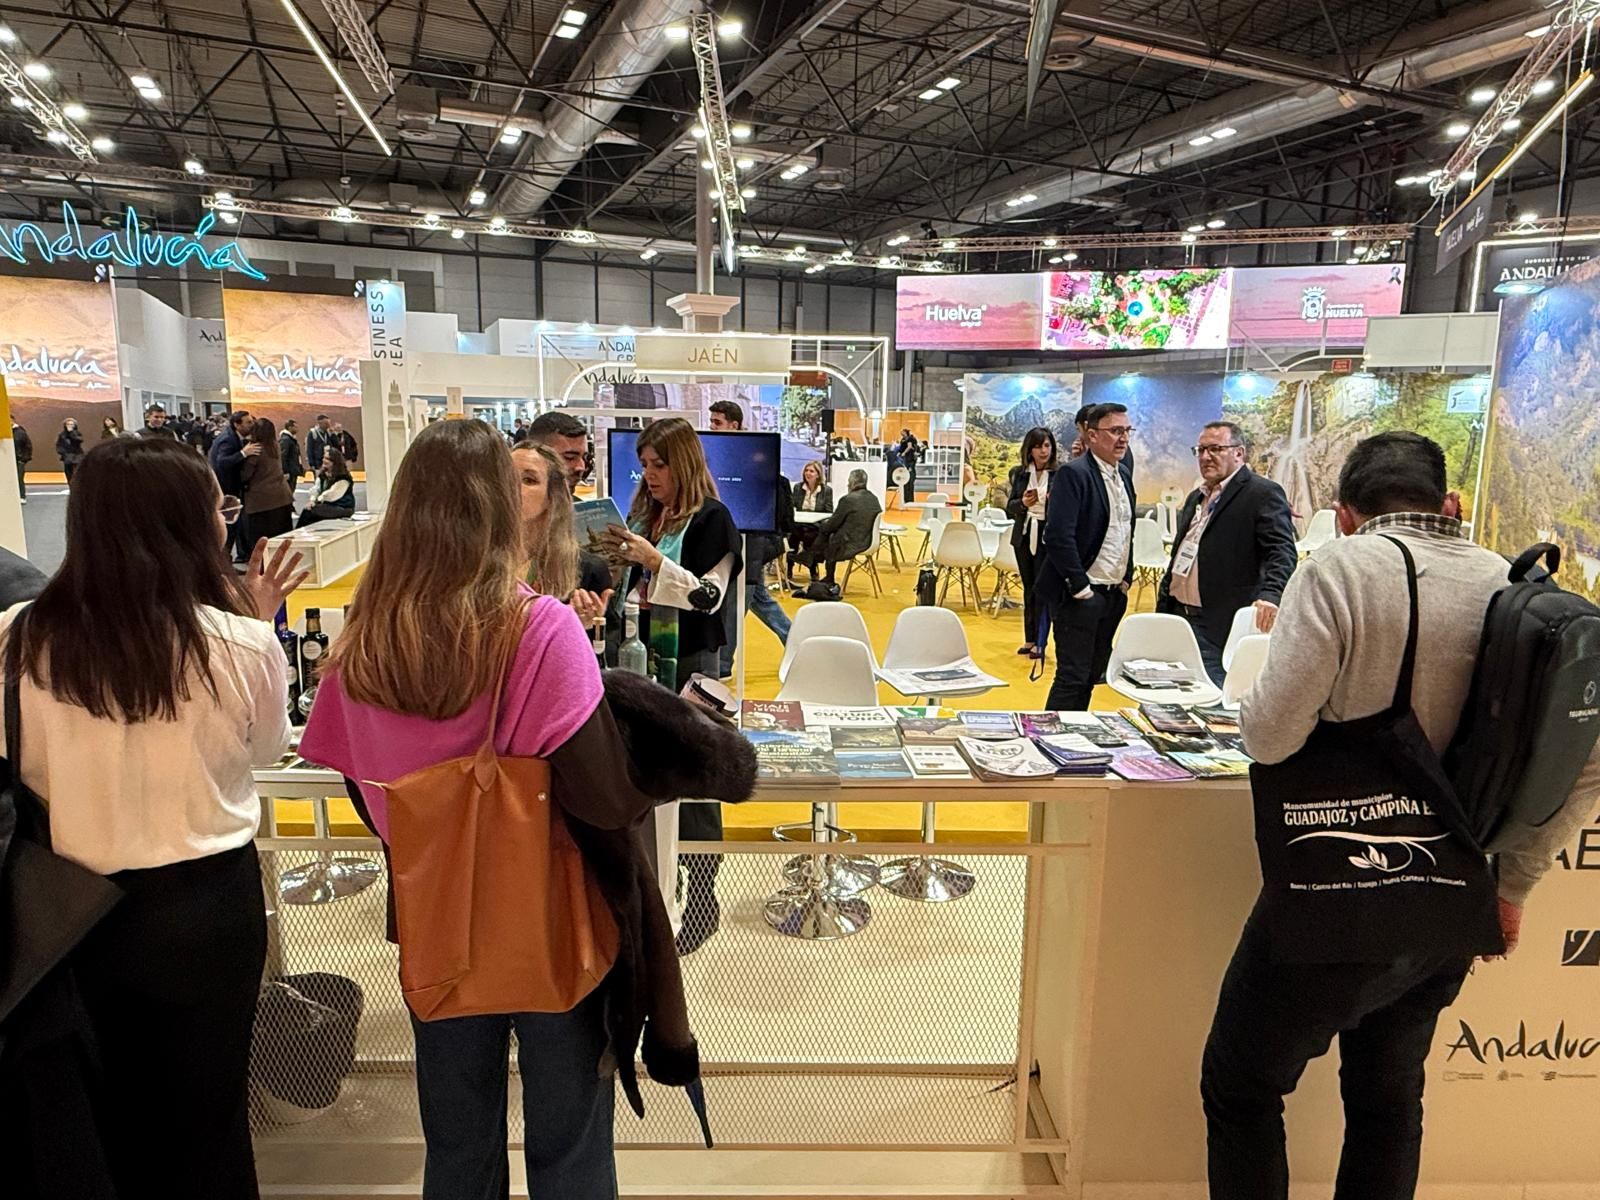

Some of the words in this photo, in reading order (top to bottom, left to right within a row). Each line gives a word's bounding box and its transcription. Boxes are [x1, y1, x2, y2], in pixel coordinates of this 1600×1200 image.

[926, 304, 982, 321] Huelva
[1325, 308, 1363, 318] HUELVA
[688, 343, 738, 363] JAÉN
[1283, 799, 1339, 810] Mancomunidad
[1340, 798, 1350, 807] de
[1351, 793, 1393, 807] municipios
[1284, 809, 1349, 827] GUADAJOZ
[1350, 811, 1358, 826] y
[1359, 796, 1421, 821] CAMPIÑA
